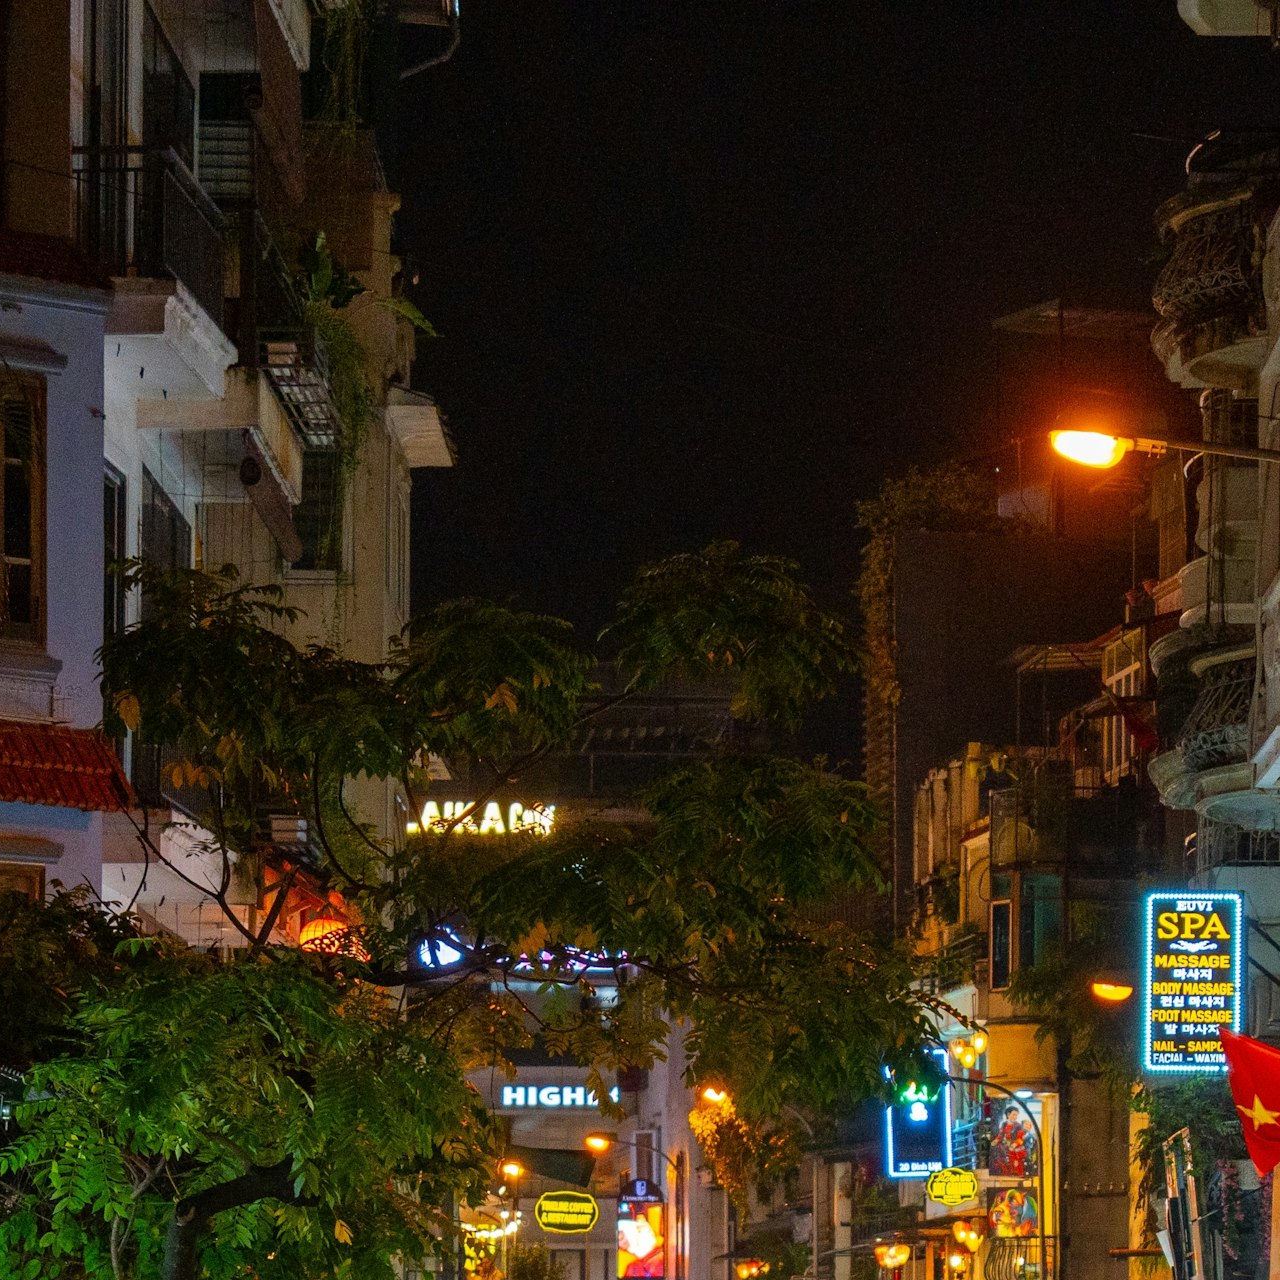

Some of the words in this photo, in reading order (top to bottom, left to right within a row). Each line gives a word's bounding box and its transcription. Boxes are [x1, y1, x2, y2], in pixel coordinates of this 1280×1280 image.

[1157, 912, 1230, 939] SPA
[1155, 955, 1230, 968] MASSAGE
[1173, 968, 1212, 980] 마사지
[1153, 982, 1181, 995] BODY
[1183, 982, 1234, 995] MASSAGE
[1189, 996, 1224, 1008] 마사지
[1152, 1010, 1180, 1022] FOOT
[1181, 1010, 1233, 1022] MASSAGE
[1153, 1041, 1177, 1051] NAIL
